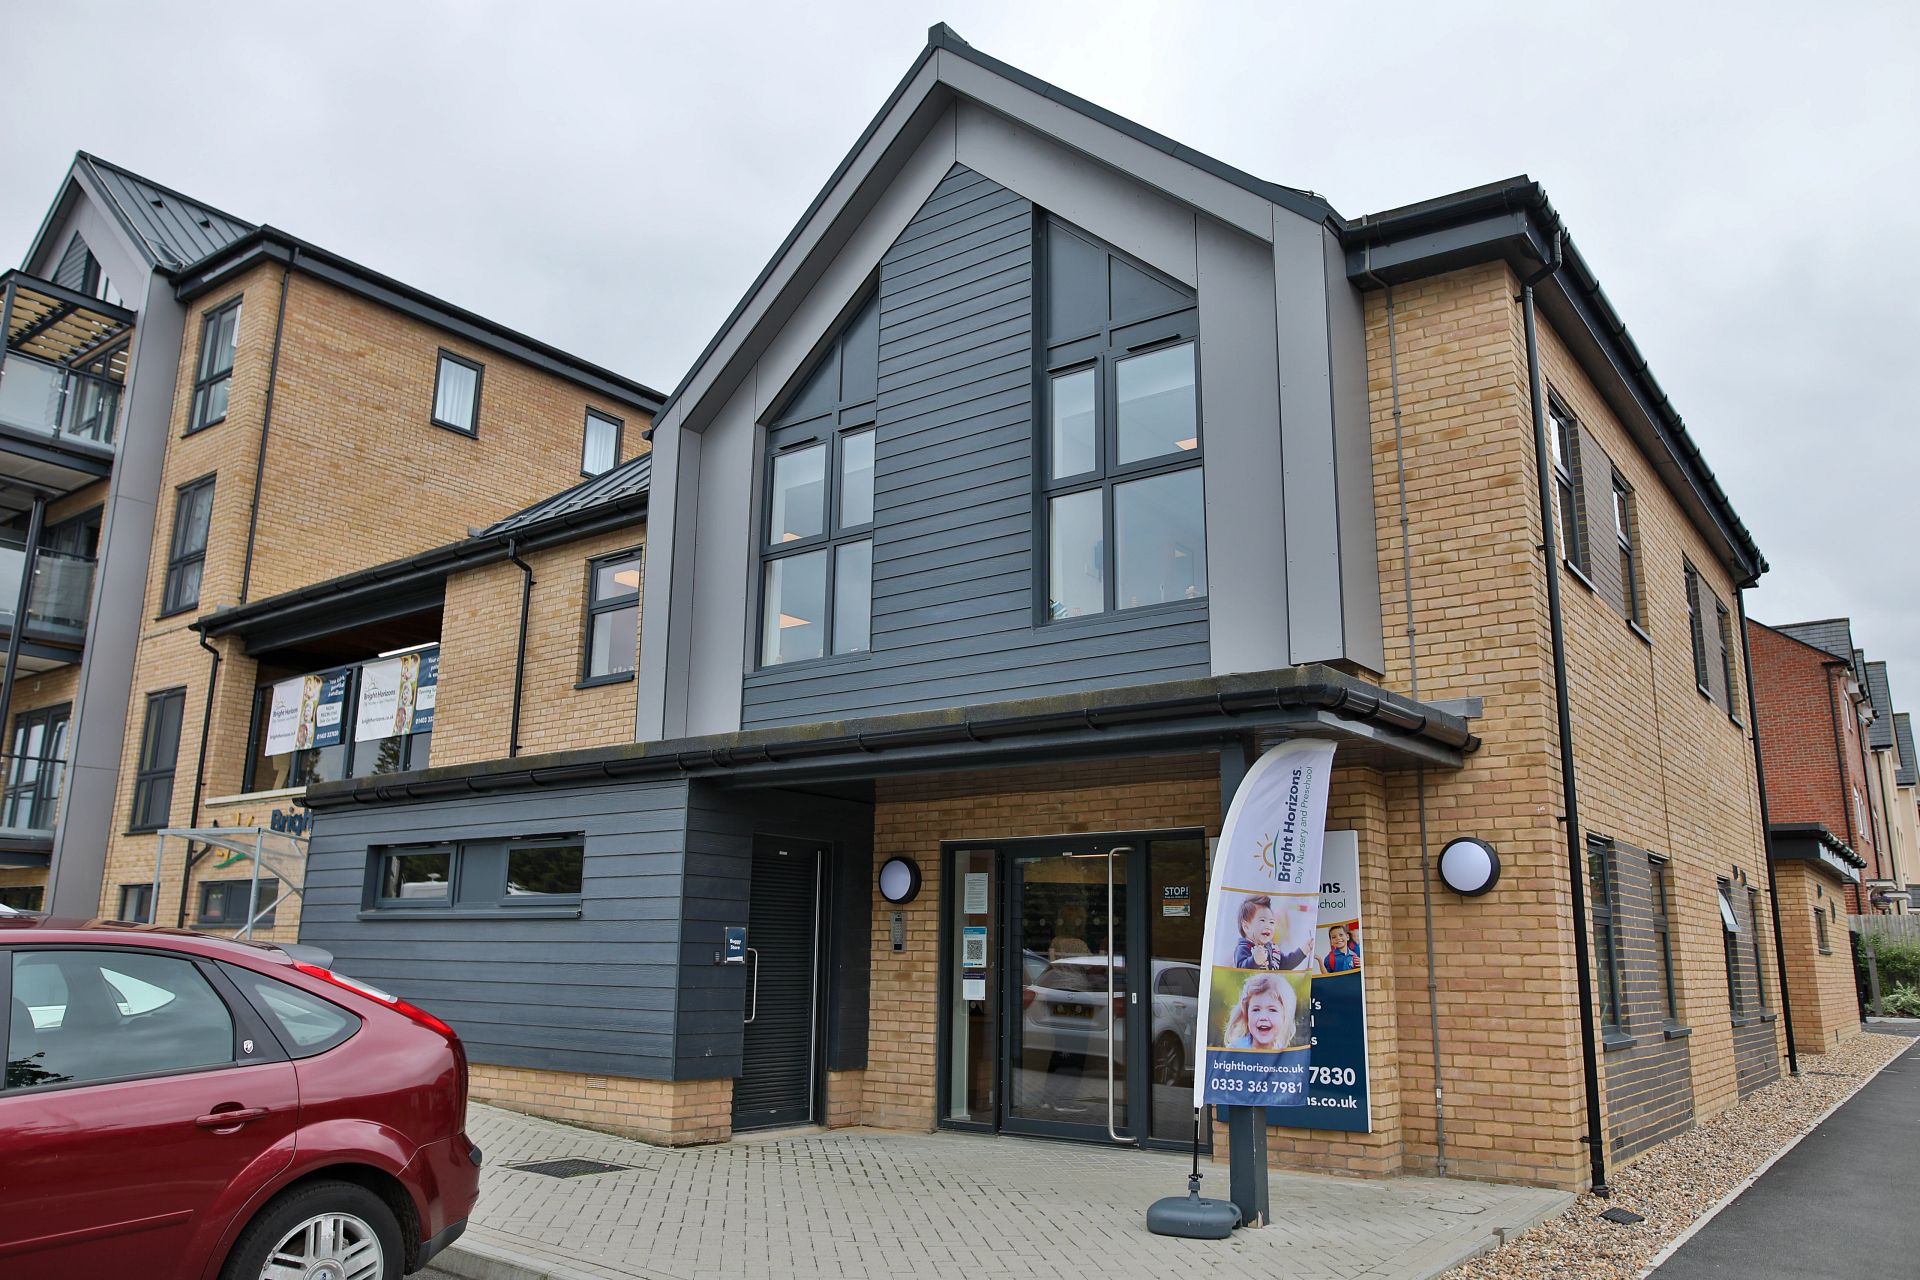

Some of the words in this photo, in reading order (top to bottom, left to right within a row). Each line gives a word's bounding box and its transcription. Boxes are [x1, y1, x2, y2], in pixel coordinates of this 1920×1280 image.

[1300, 766, 1313, 808] Preschool
[1283, 768, 1302, 834] Horizons
[1300, 810, 1308, 827] and
[1296, 830, 1309, 864] Nursery
[1277, 835, 1296, 883] Bright
[1294, 866, 1305, 884] Day
[1164, 886, 1189, 896] STOP!
[1213, 1059, 1304, 1074] brighthorizons.co.uk
[1308, 1066, 1356, 1086] 7830
[1211, 1078, 1244, 1092] 0333
[1247, 1080, 1268, 1093] 363
[1271, 1081, 1303, 1094] 7981
